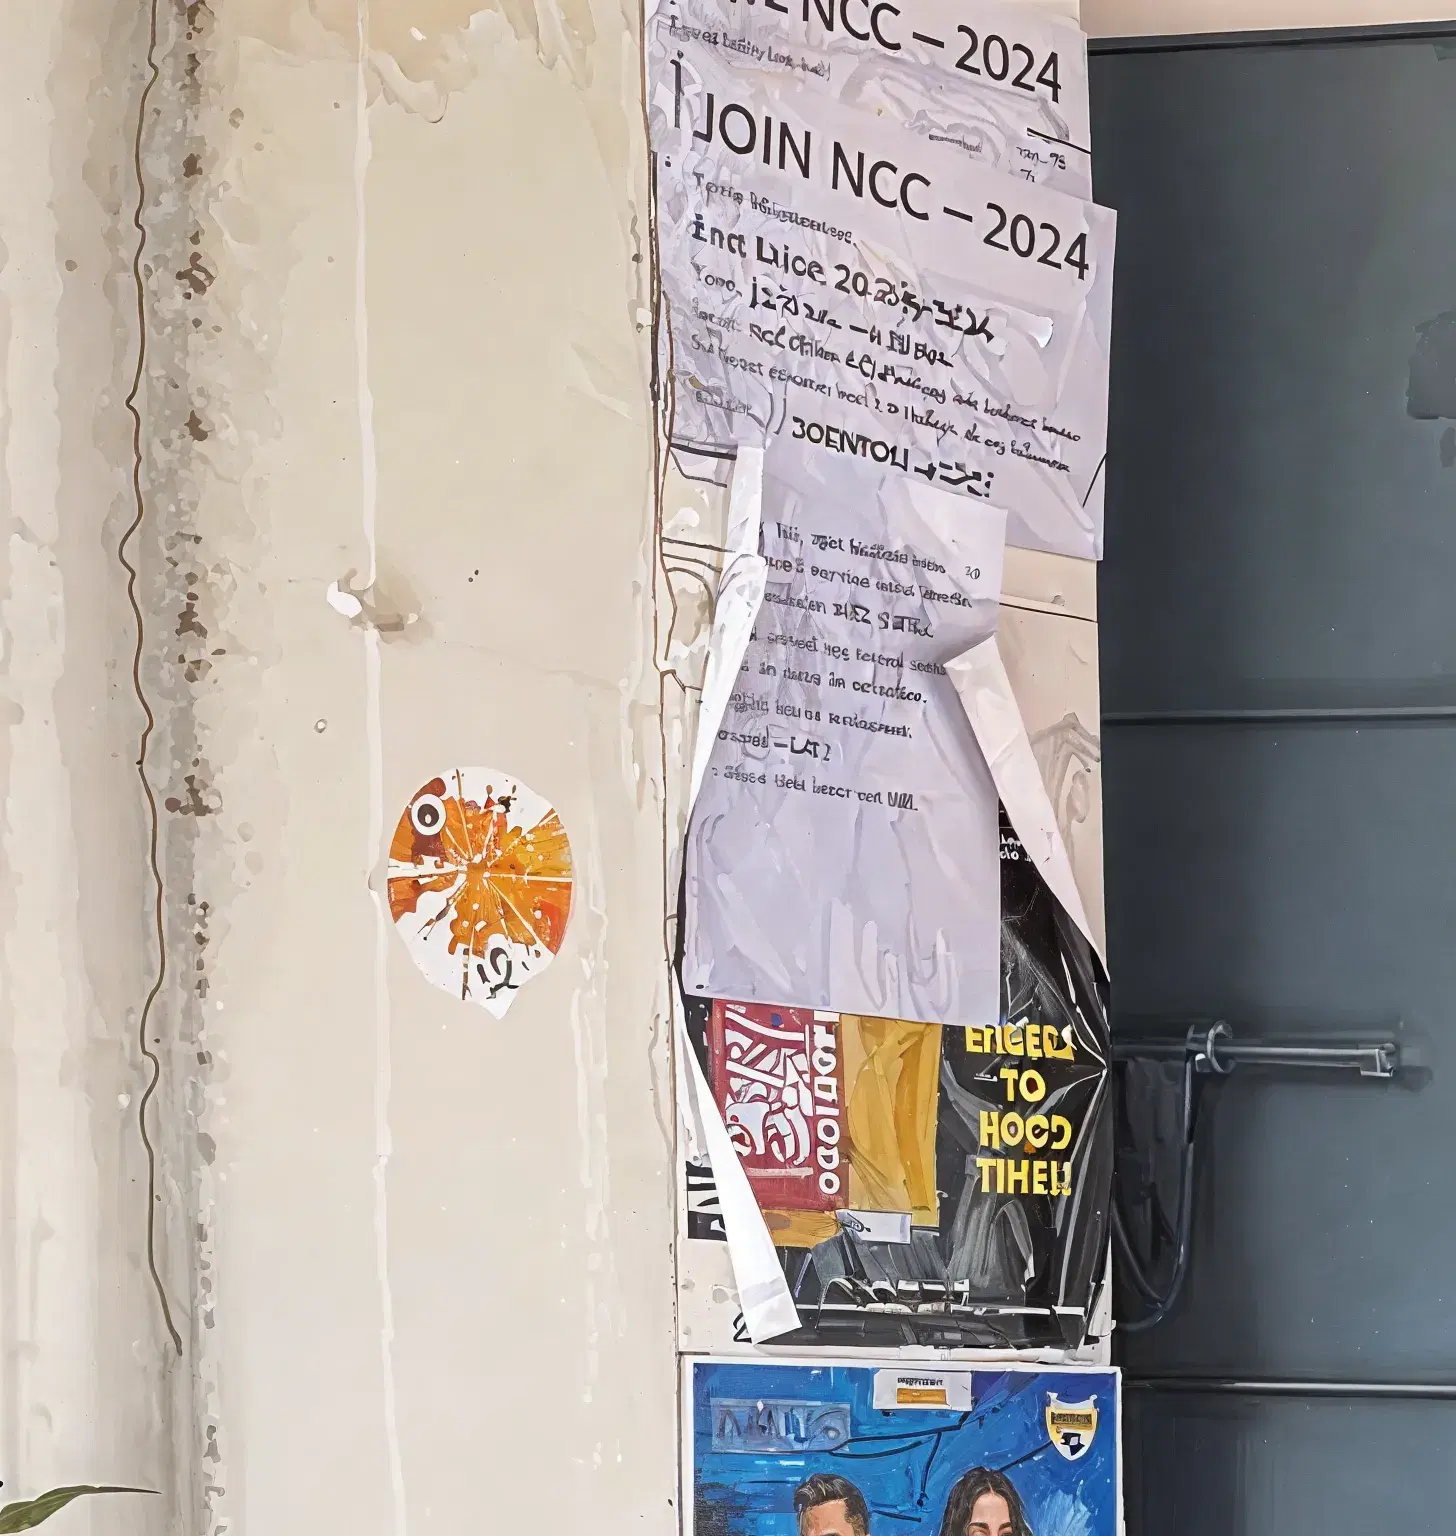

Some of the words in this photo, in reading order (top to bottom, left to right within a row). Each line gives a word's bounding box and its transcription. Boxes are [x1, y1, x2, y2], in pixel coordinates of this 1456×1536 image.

[955, 25, 1063, 102] 2024
[692, 92, 811, 179] JOIN
[832, 141, 932, 221] NCC
[983, 203, 1090, 281] 2024
[999, 1067, 1046, 1103] TO
